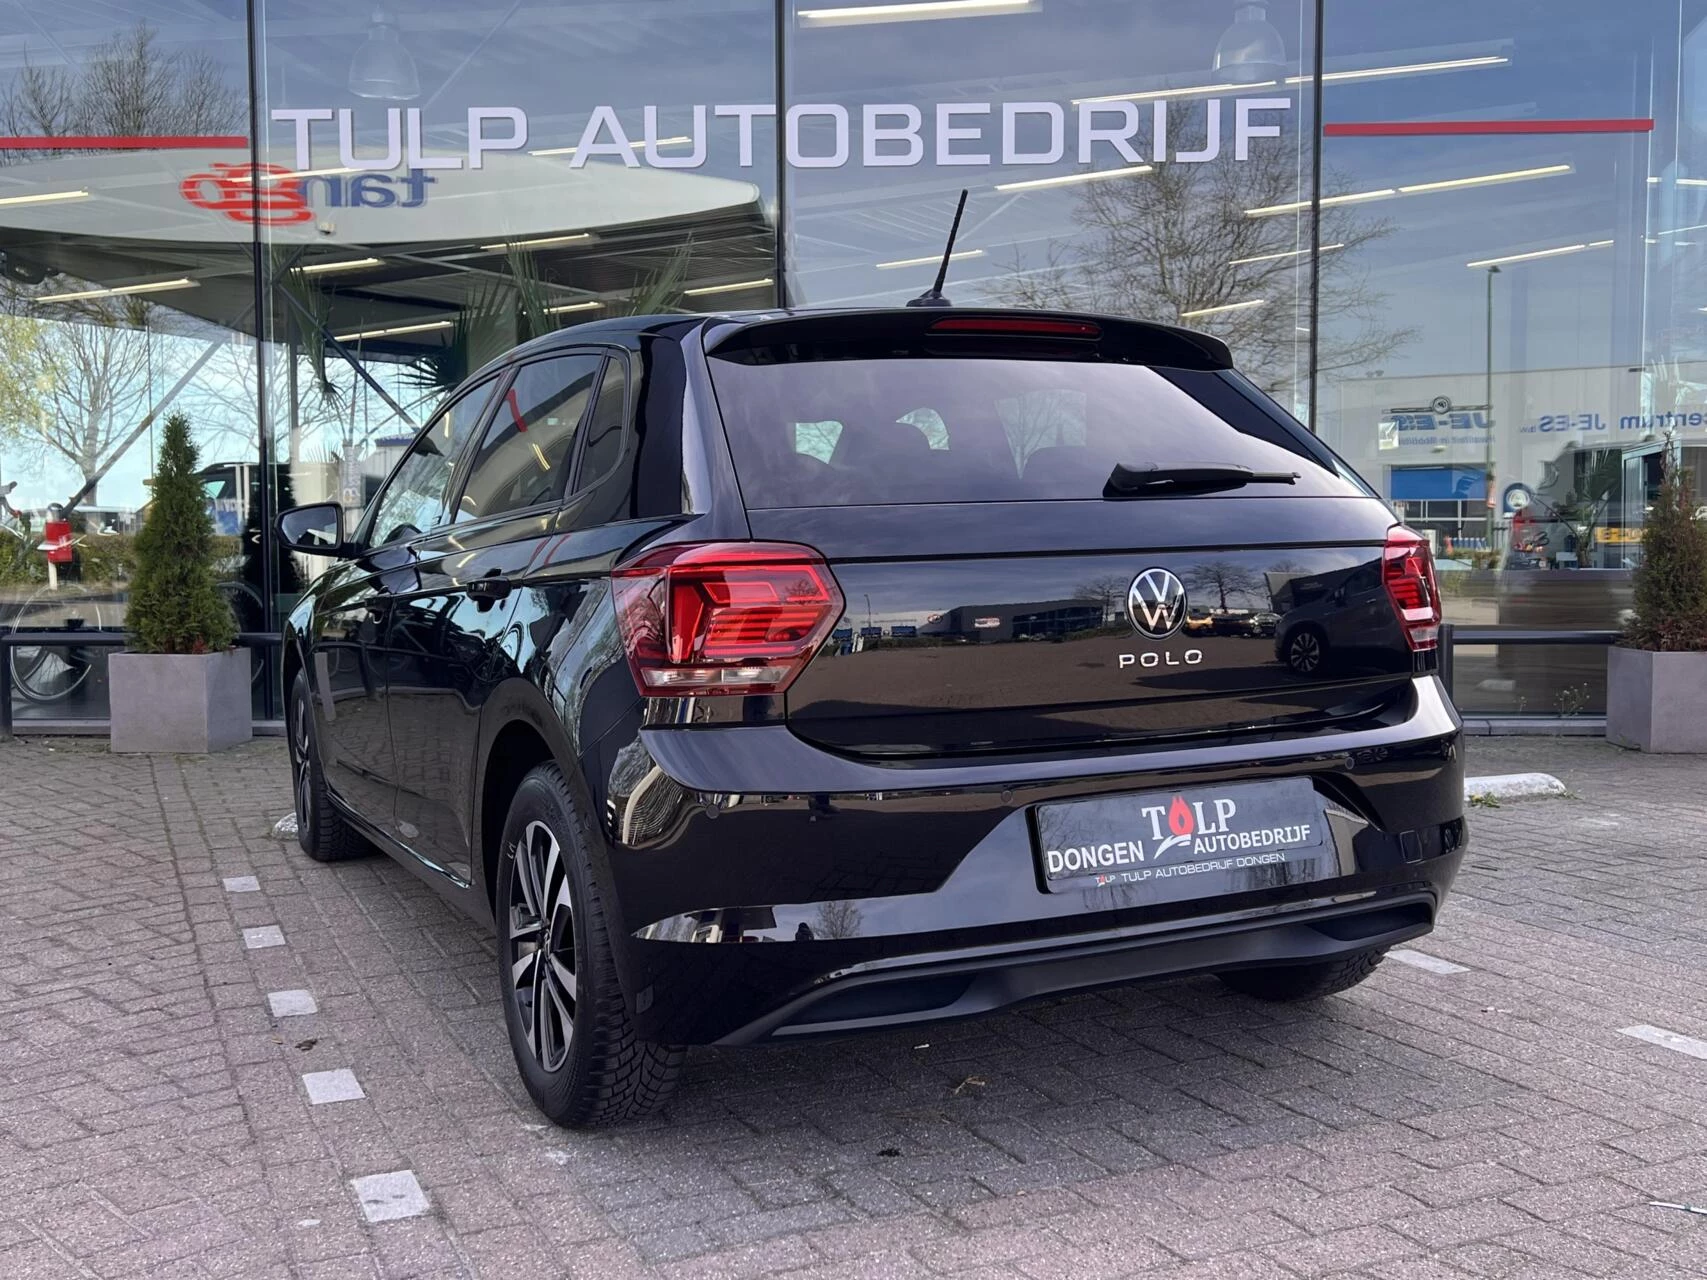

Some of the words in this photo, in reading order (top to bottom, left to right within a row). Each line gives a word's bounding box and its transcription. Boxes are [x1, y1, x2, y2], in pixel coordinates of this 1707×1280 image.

[271, 107, 528, 170] TULP
[570, 98, 1290, 169] AUTOBEDRIJF
[1118, 649, 1203, 669] POLO
[1047, 840, 1145, 873] DONGEN
[1194, 825, 1311, 855] AUTOBEDRIJF
[1121, 870, 1151, 882] TULP
[1155, 860, 1233, 878] AUTOBEDRIJF
[1236, 852, 1286, 868] DONGEN
